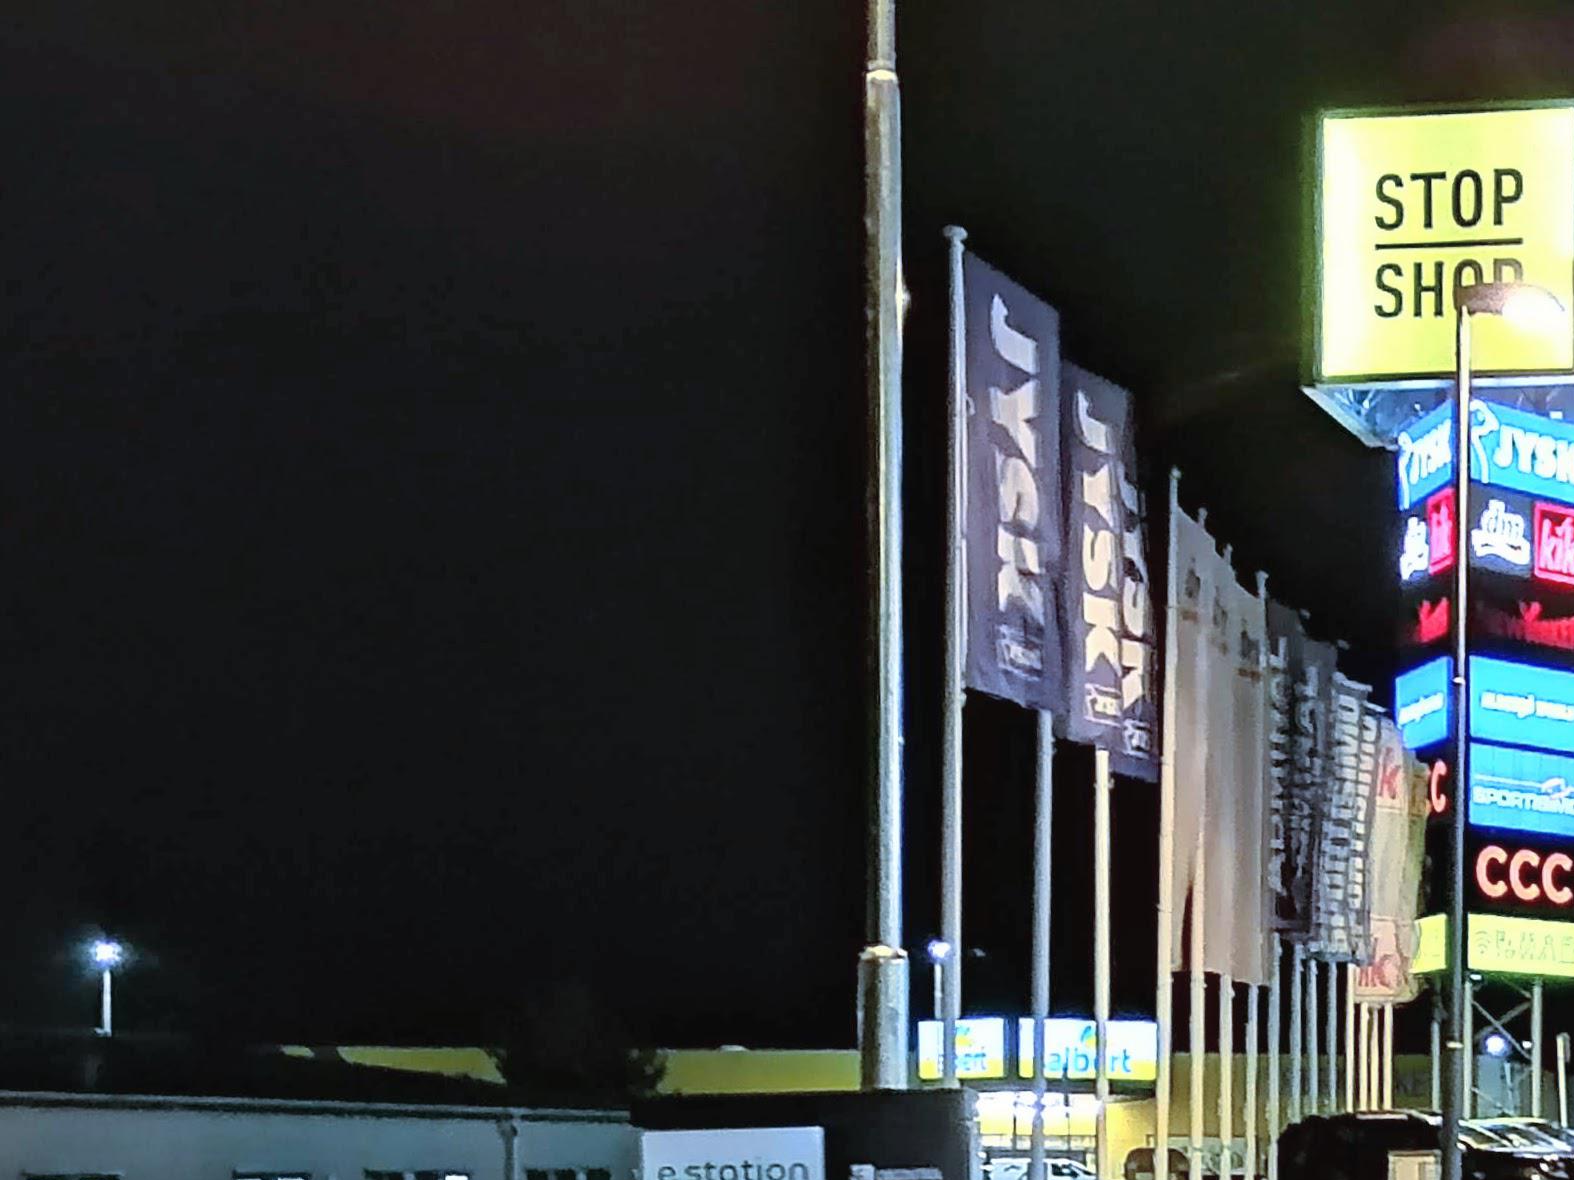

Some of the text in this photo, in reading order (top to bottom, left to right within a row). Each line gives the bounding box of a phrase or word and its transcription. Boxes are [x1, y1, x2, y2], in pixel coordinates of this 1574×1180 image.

[1374, 168, 1525, 231] STOP
[989, 292, 1046, 627] JYSK
[1076, 388, 1123, 677] JYSK
[1475, 845, 1574, 904] CCC
[1048, 1047, 1132, 1074] albrt
